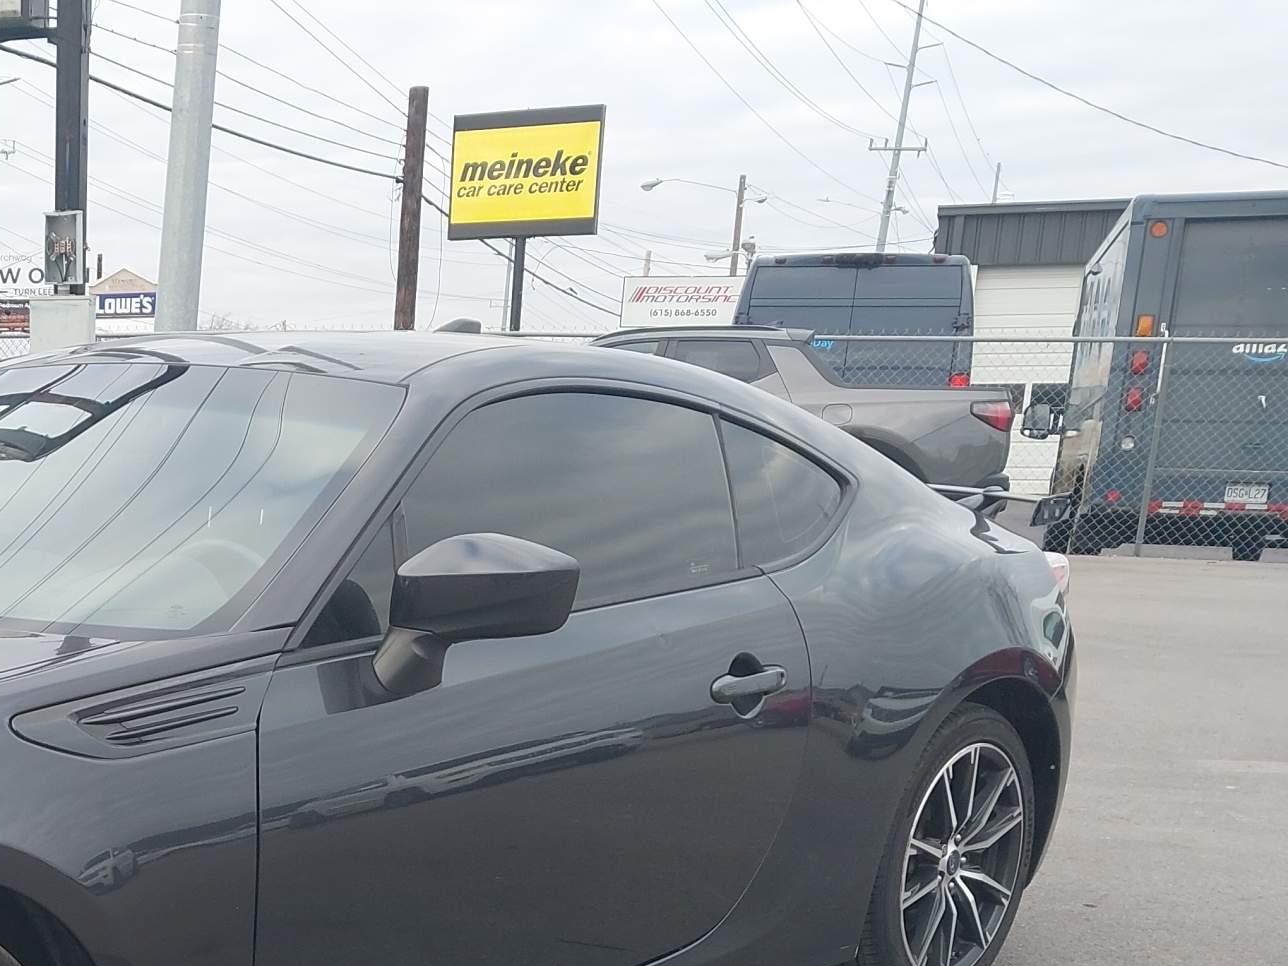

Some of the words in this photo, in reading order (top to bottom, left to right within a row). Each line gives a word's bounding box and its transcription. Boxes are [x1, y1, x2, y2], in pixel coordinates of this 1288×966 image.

[459, 149, 589, 182] meineke
[456, 184, 483, 198] car
[487, 182, 524, 196] care
[528, 177, 584, 194] center
[13, 288, 35, 296] TURN
[645, 286, 734, 294] DISCOUNT
[95, 294, 153, 314] LOWE'S
[649, 308, 672, 318] (615)
[674, 308, 718, 317] 868-6550
